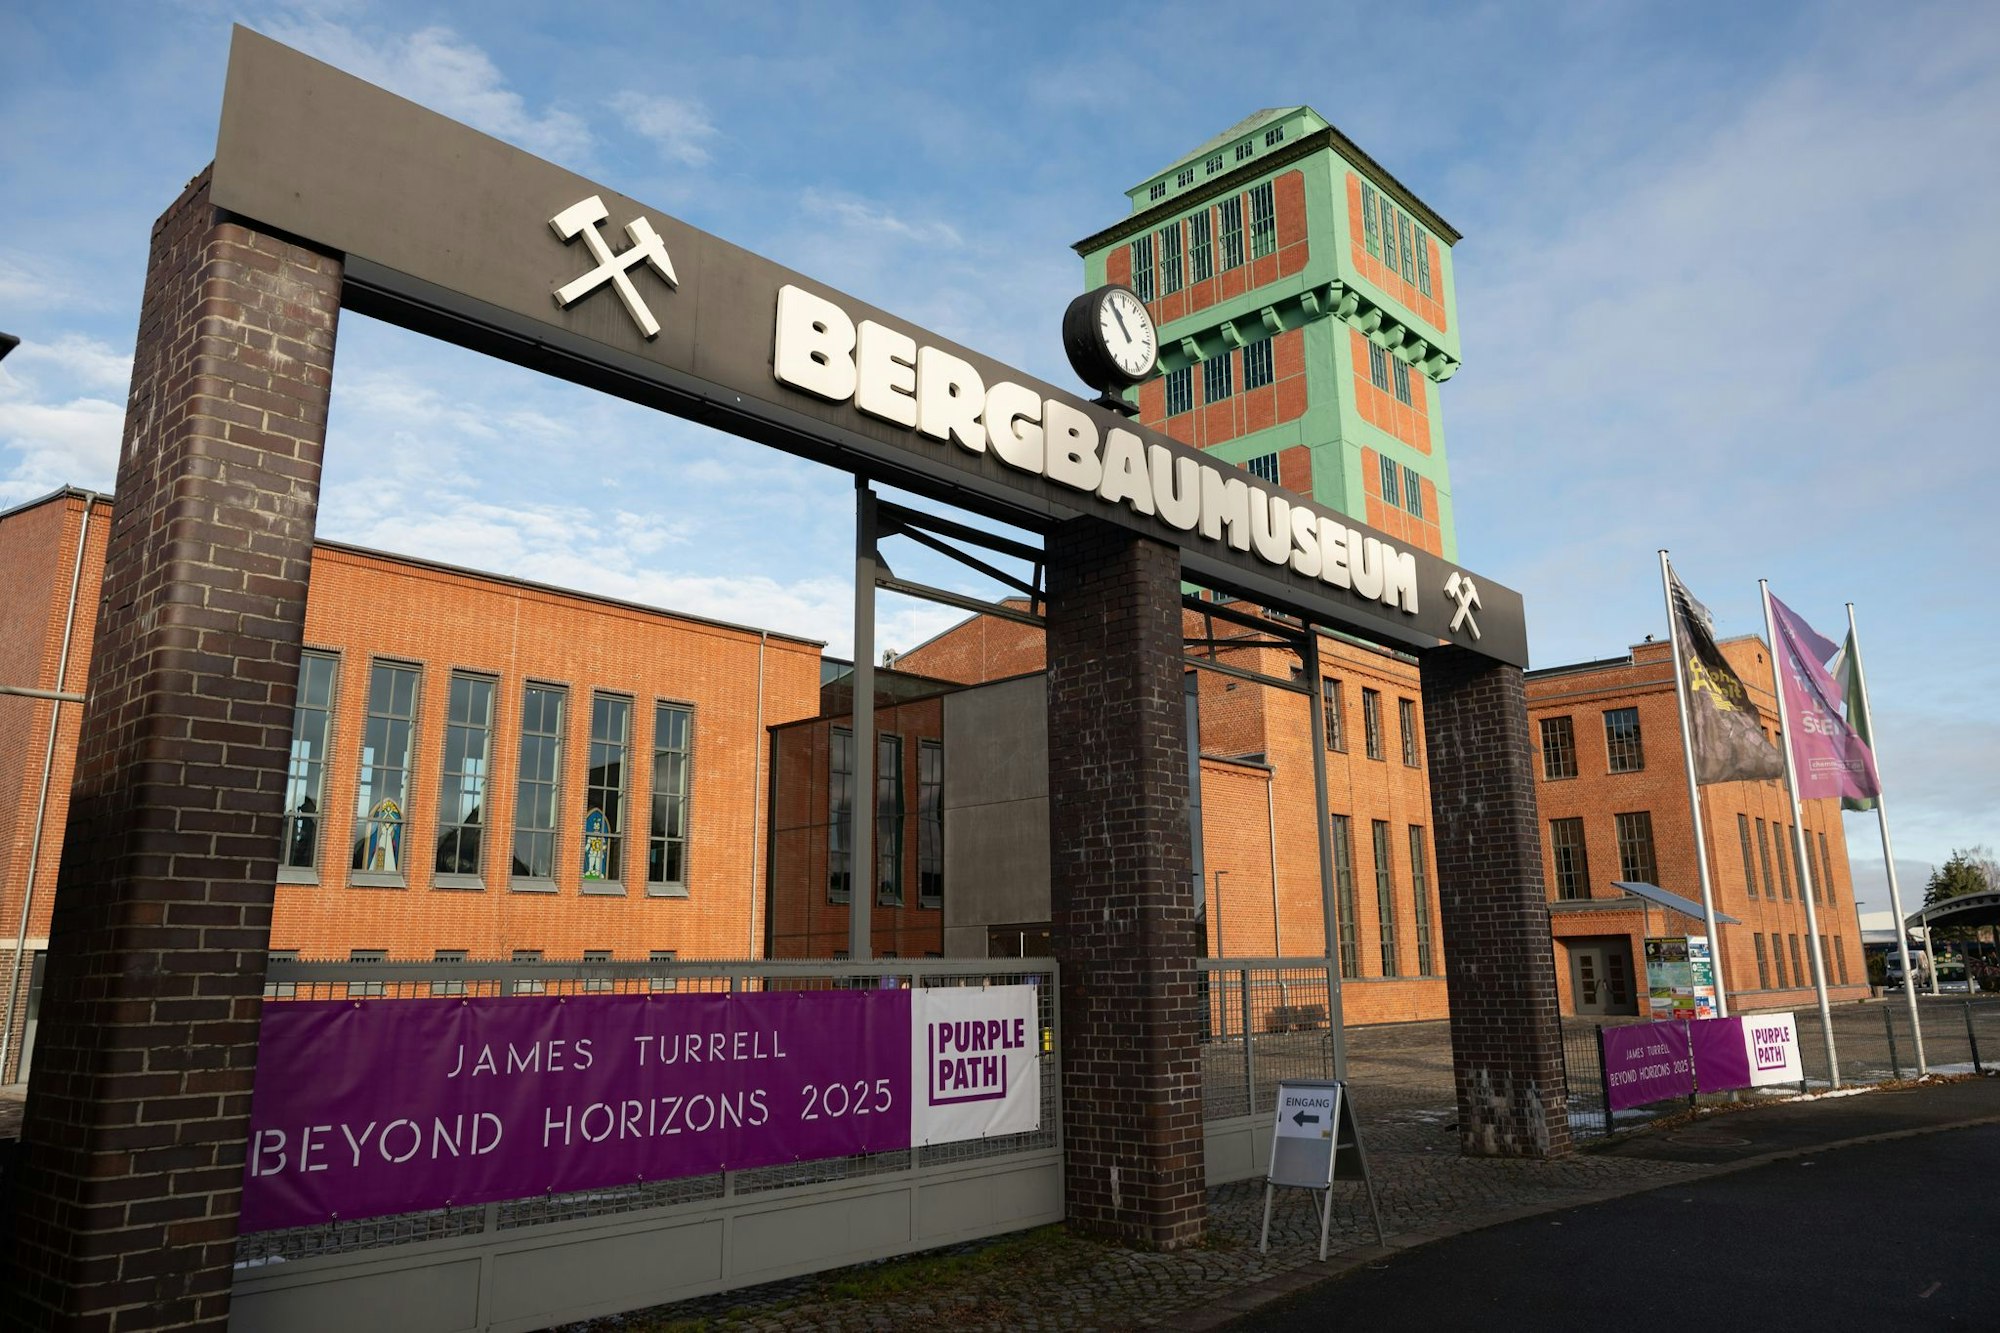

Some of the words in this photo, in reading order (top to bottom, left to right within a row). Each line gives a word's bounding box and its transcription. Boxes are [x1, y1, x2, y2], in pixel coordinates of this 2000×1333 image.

[774, 284, 1419, 615] BERGBAUMUSEUM
[939, 1019, 1024, 1054] PURPLE
[1755, 1026, 1790, 1045] PURPLE
[447, 1039, 593, 1078] JAMES
[634, 1030, 786, 1066] TURRELL
[1626, 1047, 1644, 1060] JAMES
[1647, 1043, 1670, 1056] TURRELL
[1758, 1046, 1782, 1063] PATH
[939, 1056, 997, 1091] PATH
[1610, 1069, 1637, 1086] BEYOND
[1640, 1062, 1670, 1080] HORIZONS
[1673, 1059, 1689, 1074] 2025
[1286, 1097, 1330, 1108] EINGANG
[251, 1112, 503, 1177] BEYOND
[544, 1090, 769, 1147] HORIZONS
[801, 1079, 892, 1120] 2025
